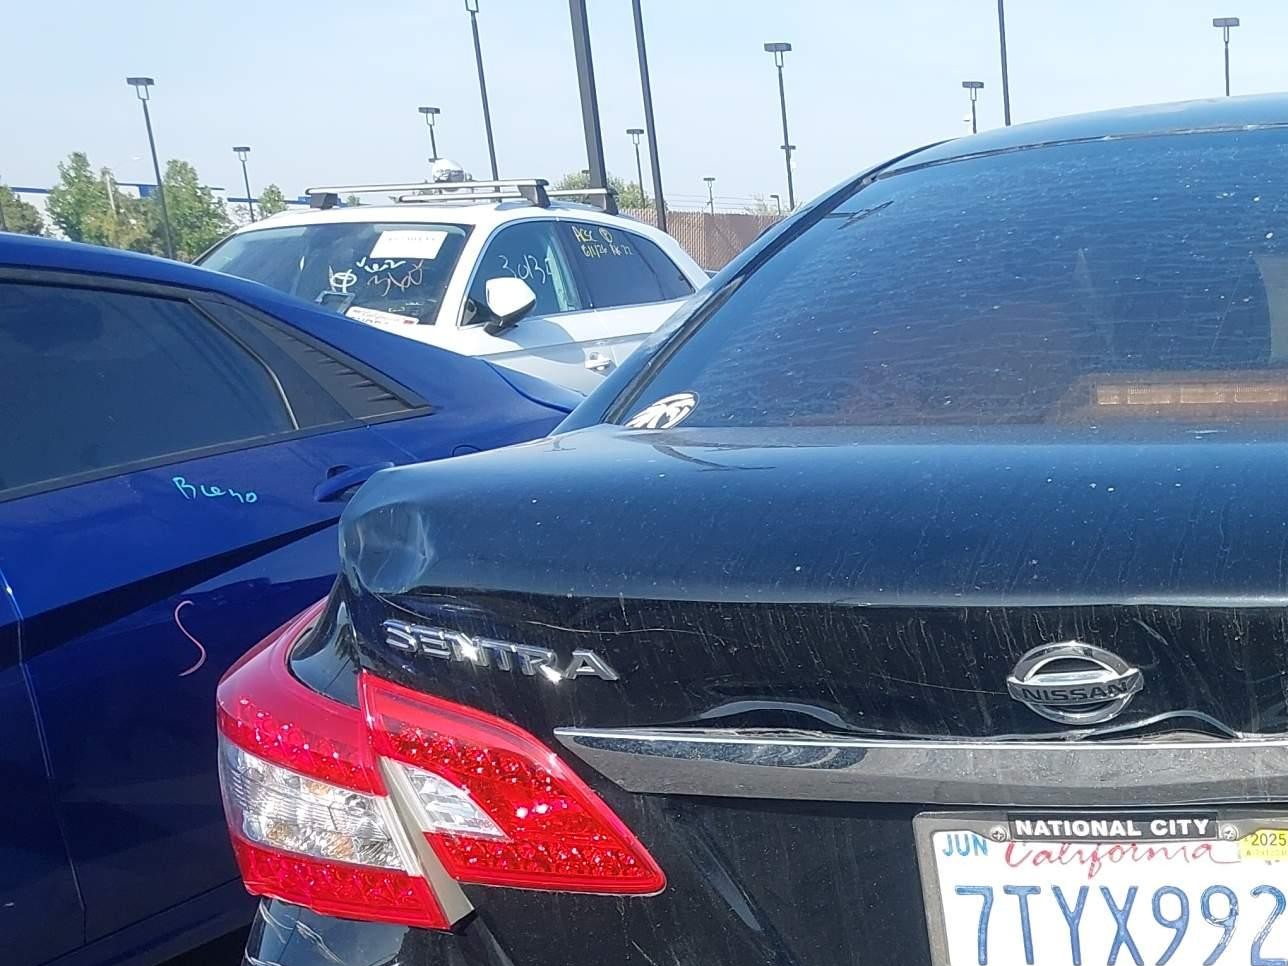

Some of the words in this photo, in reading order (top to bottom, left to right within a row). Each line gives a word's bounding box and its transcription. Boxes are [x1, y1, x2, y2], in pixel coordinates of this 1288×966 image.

[383, 618, 621, 682] SENTRA
[1022, 681, 1128, 701] NISSAN
[1015, 819, 1143, 837] NATIONAL
[1150, 819, 1210, 837] CITY
[1251, 833, 1287, 846] 2025
[942, 833, 988, 857] JUN
[1004, 839, 1242, 880] California
[955, 884, 1288, 966] 7TYX992
